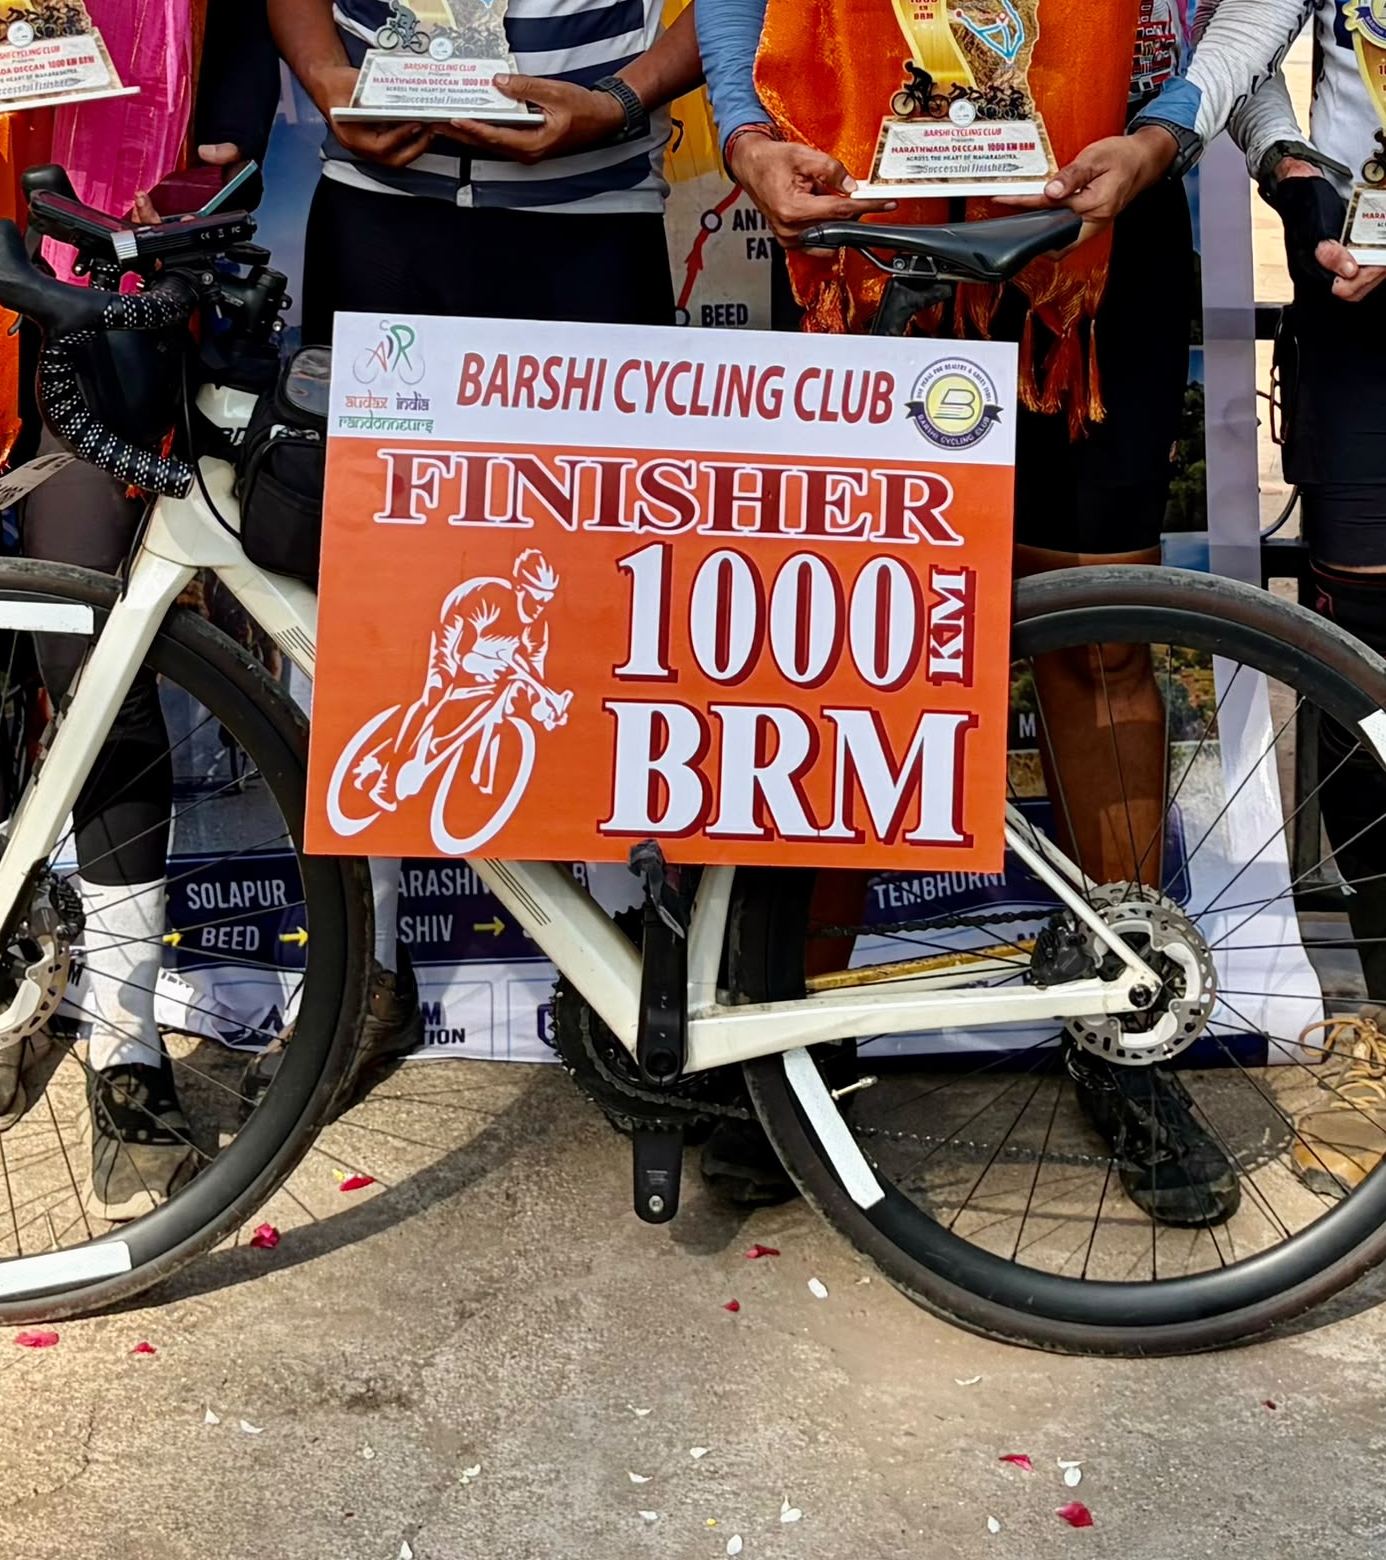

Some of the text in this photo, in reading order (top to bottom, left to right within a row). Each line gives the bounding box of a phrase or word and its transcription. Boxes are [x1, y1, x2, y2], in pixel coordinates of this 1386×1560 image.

[43, 46, 60, 54] CLUB
[983, 128, 1001, 136] CLUB
[701, 304, 748, 327] BEED
[345, 390, 430, 412] audax india
[456, 352, 895, 425] BARSHI CYCLING CLUB
[941, 435, 974, 445] CYCLING
[975, 416, 990, 436] CLUB
[374, 448, 965, 546] FINISHER
[613, 542, 977, 690] 1000 KM
[598, 697, 978, 848] BRM
[186, 879, 288, 911] SOLAPUR
[874, 870, 1007, 909] TEMBHURNI
[201, 925, 260, 951] BEED
